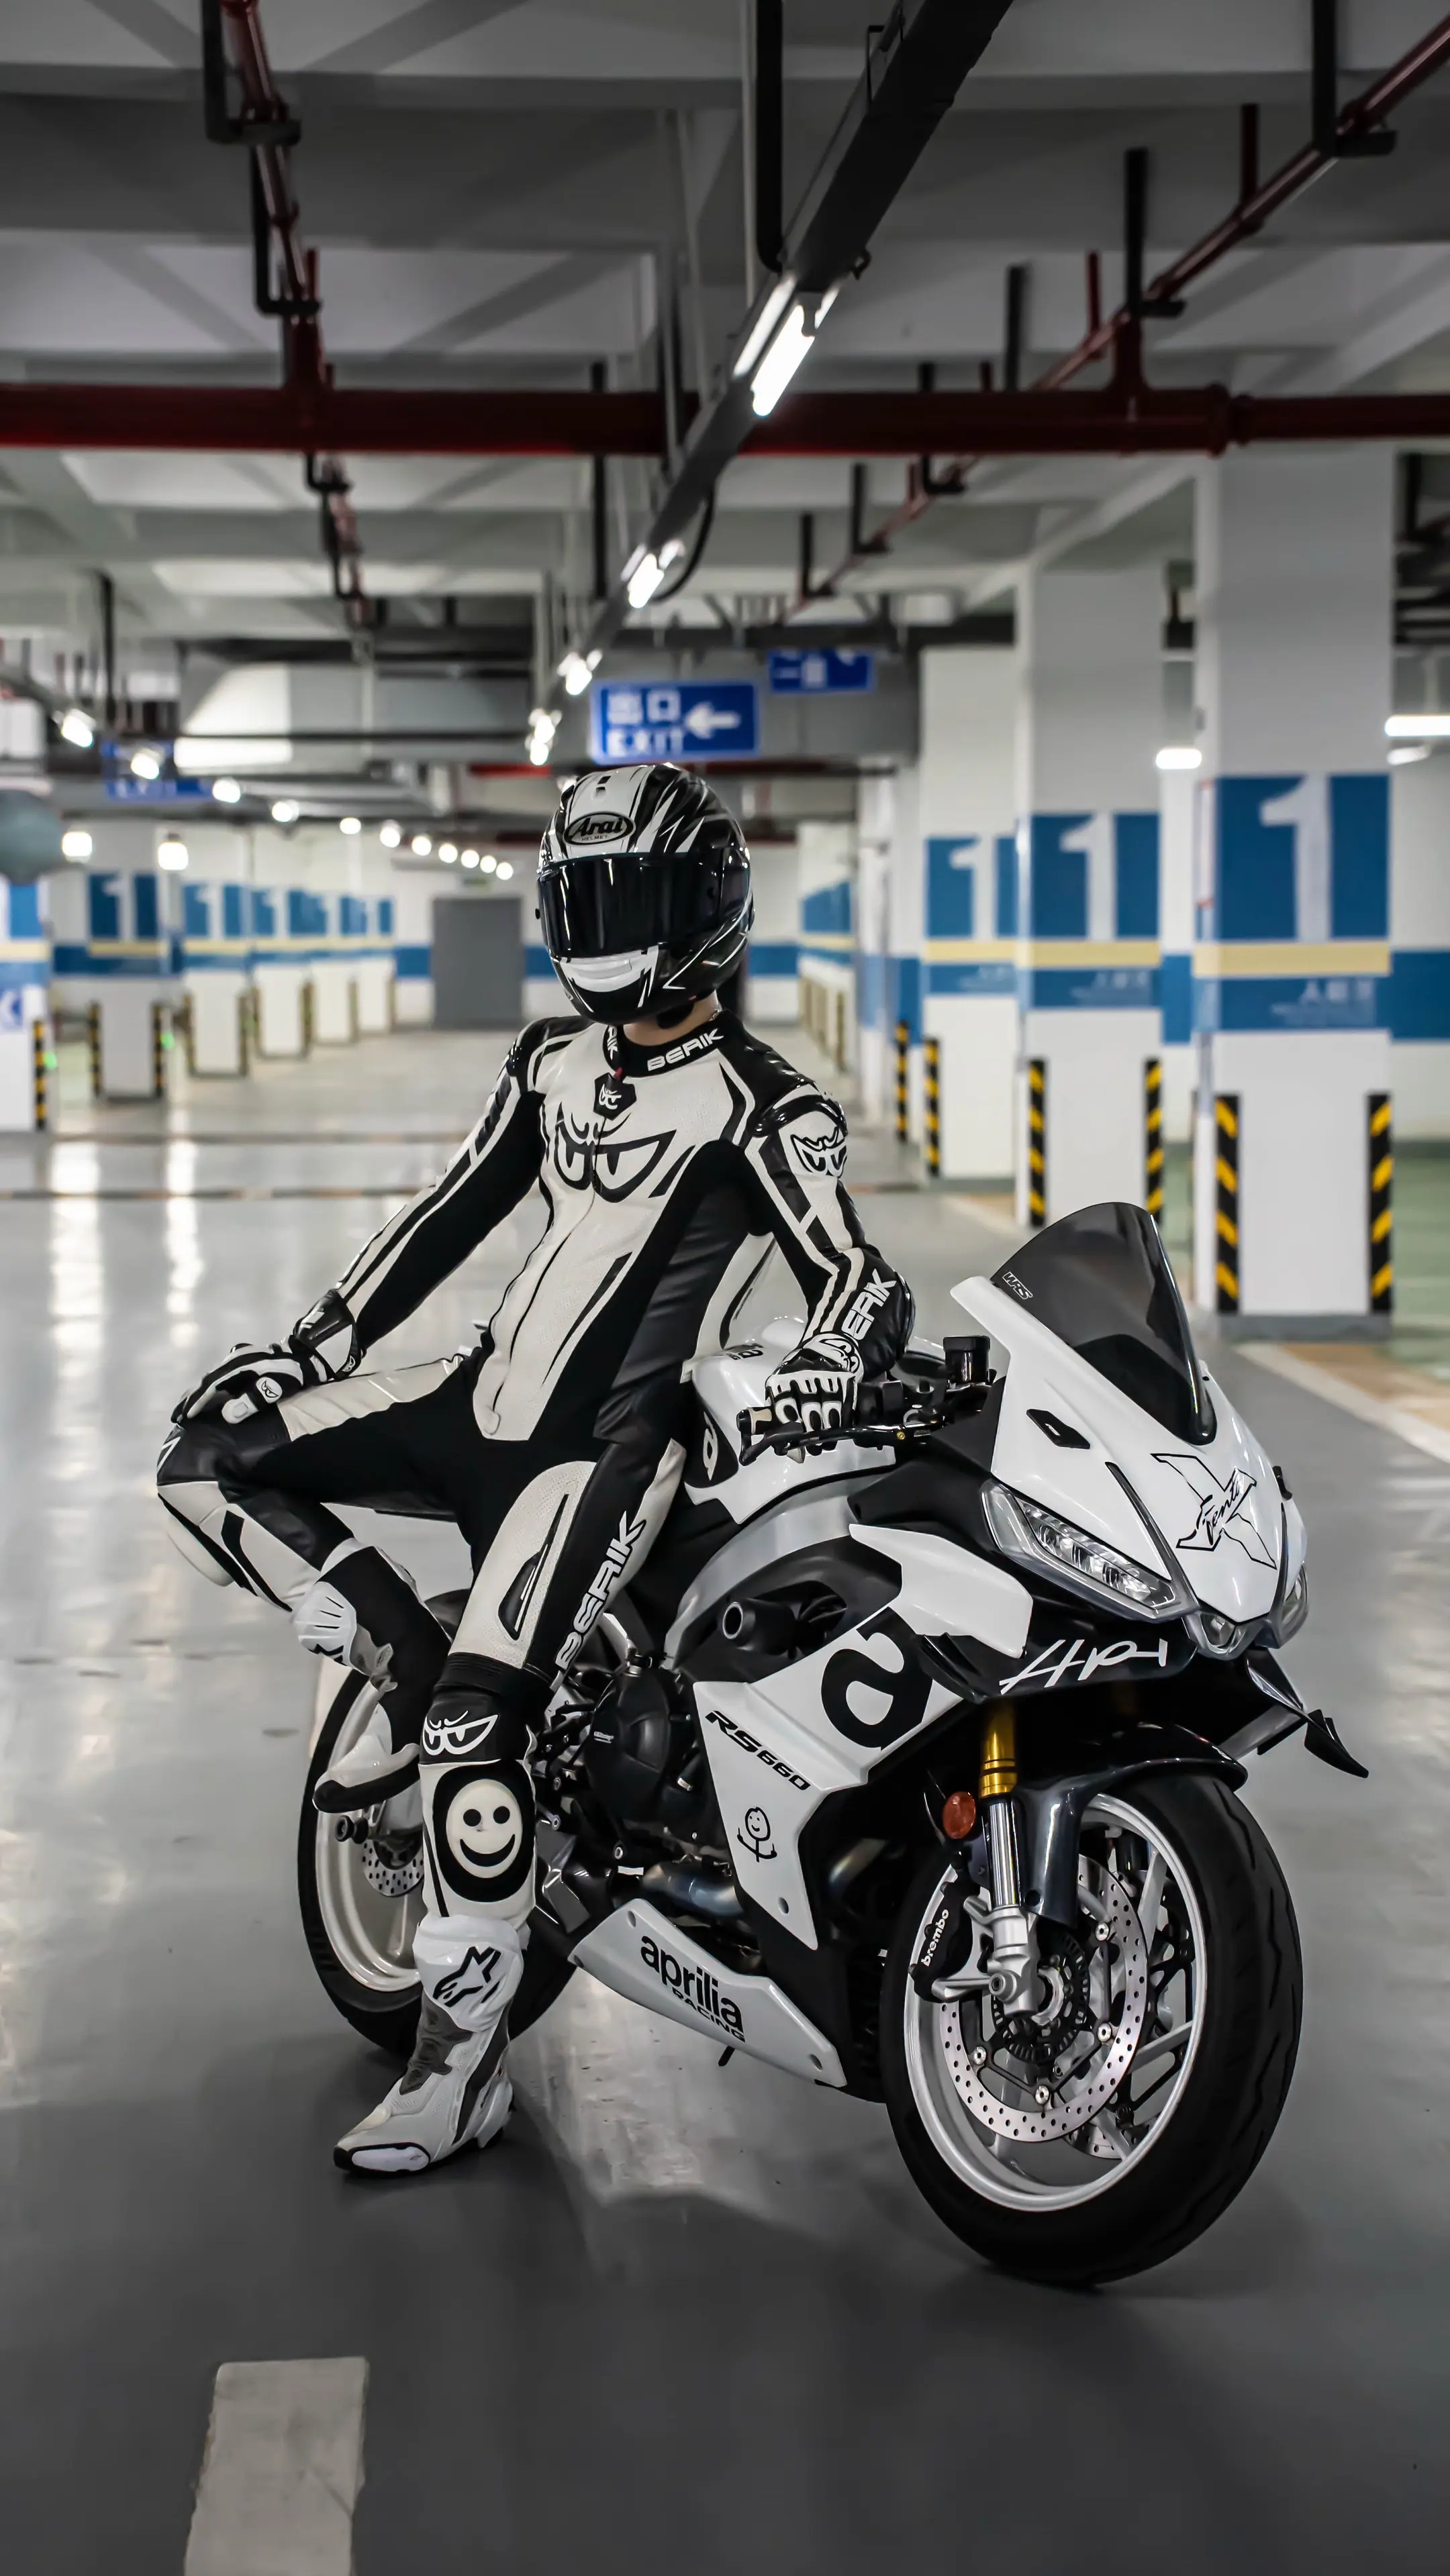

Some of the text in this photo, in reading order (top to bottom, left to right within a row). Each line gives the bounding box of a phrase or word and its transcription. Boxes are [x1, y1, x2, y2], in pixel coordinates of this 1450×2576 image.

[569, 817, 624, 840] Arai
[1261, 775, 1328, 941] 1
[607, 1024, 618, 1060] RIK
[647, 1028, 724, 1071] BERIK
[841, 1268, 897, 1340] ERIK
[1002, 1271, 1033, 1299] WRS
[555, 1510, 646, 1670] BERIK
[921, 1910, 949, 1967] brembo
[640, 1936, 744, 2034] aprilia
[672, 1987, 746, 2042] RACING
